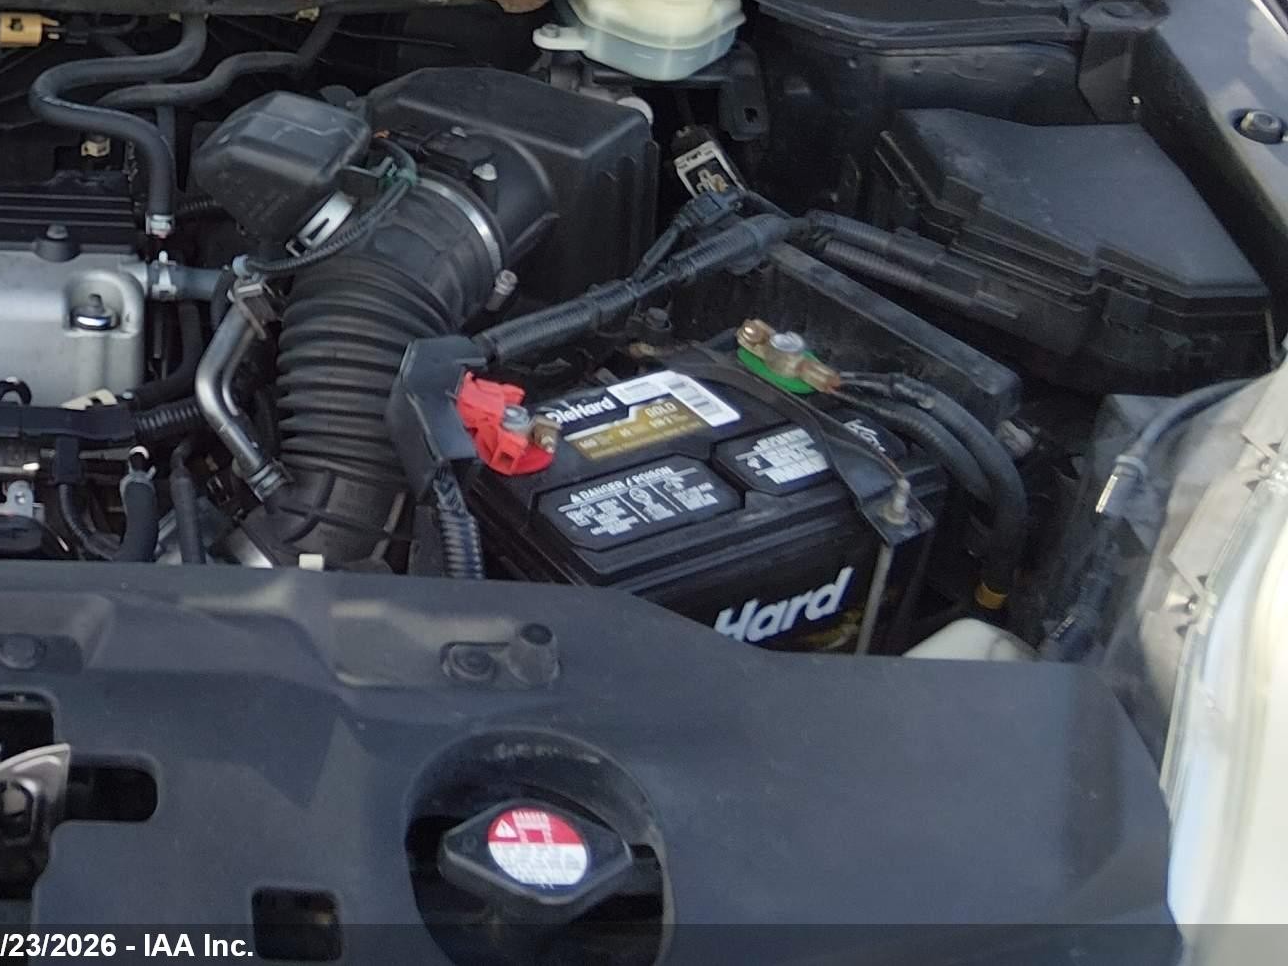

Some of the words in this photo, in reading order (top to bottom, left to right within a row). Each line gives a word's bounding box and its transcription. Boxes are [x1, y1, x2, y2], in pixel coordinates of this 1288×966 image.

[545, 396, 617, 424] DieHard
[645, 401, 678, 418] GOLD
[578, 480, 626, 499] DANGER
[631, 466, 674, 484] POISON
